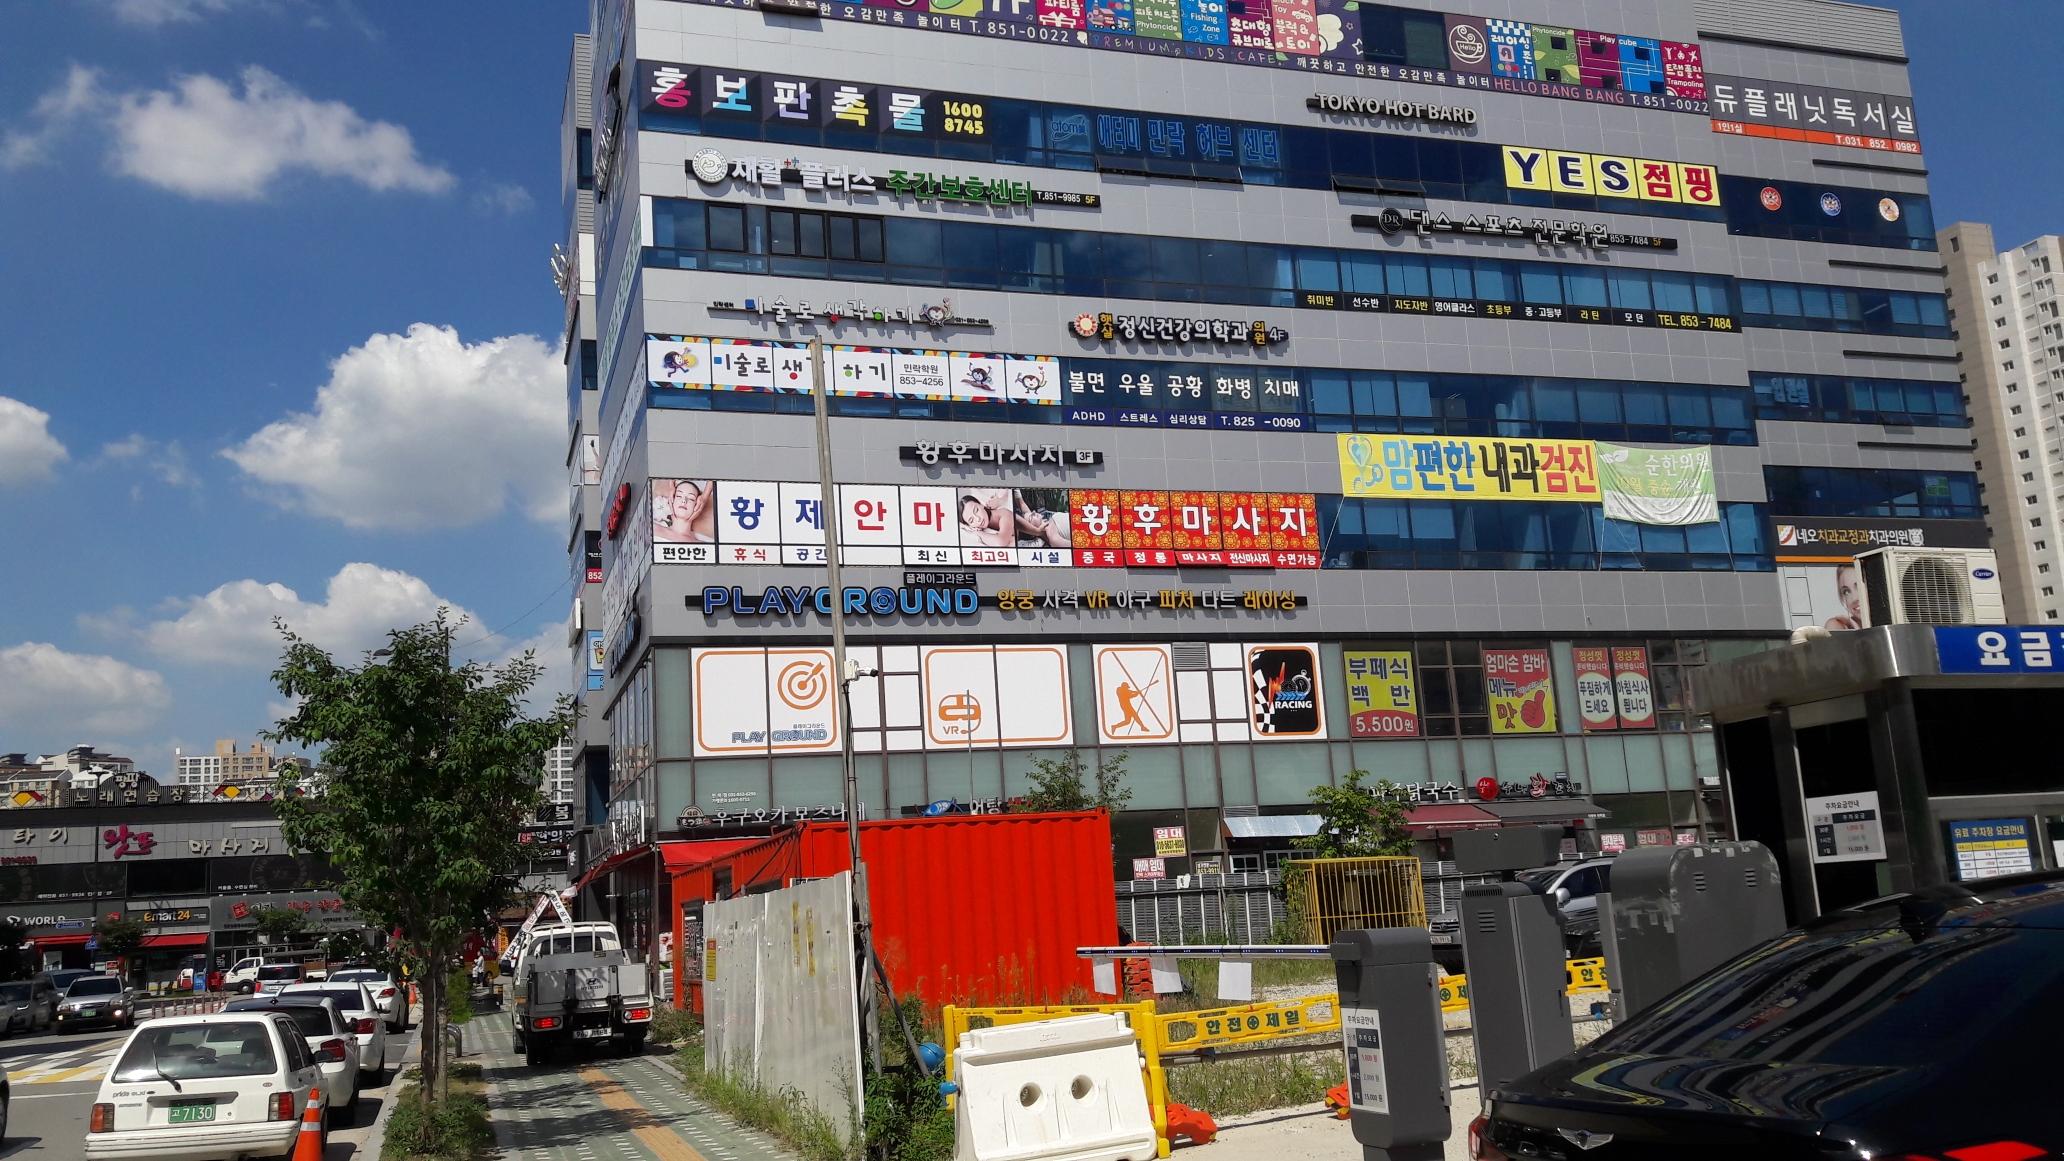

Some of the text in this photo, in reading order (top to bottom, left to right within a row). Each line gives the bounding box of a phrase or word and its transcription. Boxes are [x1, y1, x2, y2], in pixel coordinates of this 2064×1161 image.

[844, 6, 1069, 43] 오감만족 놀이터 T. 851-0022
[1136, 20, 1178, 32] Phytoncide
[1190, 13, 1218, 25] Fishing
[1202, 24, 1221, 33] Zone
[1230, 16, 1272, 37] 초대형
[1599, 34, 1638, 47] Play cube
[1297, 56, 1347, 73] 깨끗하고
[1354, 63, 1390, 79] 안전한
[1399, 68, 1446, 84] 오감만족
[1455, 73, 1490, 88] 놀이터
[1494, 76, 1538, 95] HELLO
[1541, 83, 1580, 100] BANG
[1585, 90, 1624, 106] BANG
[1629, 94, 1640, 106] T.
[942, 100, 983, 120] 1600
[1318, 91, 1477, 124] TOKYO HOT BARD
[944, 117, 985, 136] 8745
[1096, 113, 1141, 151] 애터미
[1196, 122, 1233, 157] 허브
[1243, 128, 1279, 163] 센터
[1085, 194, 1096, 205] 5F
[1408, 208, 1453, 236] 댄스
[1463, 212, 1524, 238] 스포츠
[1531, 217, 1610, 249] 전문학원
[1609, 233, 1649, 247] 853-7484
[1306, 294, 1334, 307] 취미반
[1351, 296, 1379, 309] 선수반
[1394, 299, 1429, 312] 지도자반
[1485, 304, 1512, 317] 초등부
[1117, 315, 1249, 342] 정신건강의학과
[1253, 320, 1266, 346] 의원
[1269, 326, 1286, 342] 4F
[903, 363, 939, 375] 민락학원
[899, 375, 944, 388] 853-4256
[1069, 371, 1300, 400] 불면 우울 공황 화병 치매
[1072, 411, 1106, 421] ADHD
[1119, 412, 1158, 424] 스트레스
[1169, 413, 1207, 426] 심리상담
[915, 439, 1094, 468] 황후마사지 3F
[1080, 503, 1308, 538] 황후마사지
[661, 547, 707, 562] 편안한
[732, 548, 767, 562] 휴식
[916, 549, 948, 563] 최신
[971, 550, 1010, 564] 최고의
[1030, 551, 1060, 564] 시설
[1081, 551, 1116, 565] 중국
[1133, 552, 1168, 565] 정통
[1181, 552, 1222, 564] 마사지
[1228, 553, 1271, 566] 전신마사지
[1276, 553, 1317, 566] 수면가능
[905, 572, 976, 585] 플레이그라운드
[703, 585, 980, 615] PLAYGROUND
[997, 588, 1034, 609] 양궁
[1042, 589, 1079, 609] 사격
[1085, 591, 1109, 609] VR
[1116, 589, 1152, 609] 야구
[1201, 590, 1237, 609] 다트
[1242, 590, 1297, 610] 레이싱
[1349, 657, 1409, 680] 부페식
[1486, 653, 1545, 673] 엄마손 함바
[1488, 678, 1517, 698] 메뉴
[1616, 680, 1649, 695] 아침식사
[1275, 700, 1313, 710] RACING
[1585, 699, 1610, 714] 드세요
[1496, 701, 1518, 729] 맛
[731, 729, 828, 743] PLAY GROUND
[943, 725, 960, 735] VR
[74, 788, 186, 804] 노래연습장
[13, 827, 69, 845] 타이
[1156, 828, 1183, 839] 임대
[188, 837, 270, 860] 마사지
[1206, 1009, 1299, 1036] 안전 제일
[183, 1106, 213, 1120] 7130
